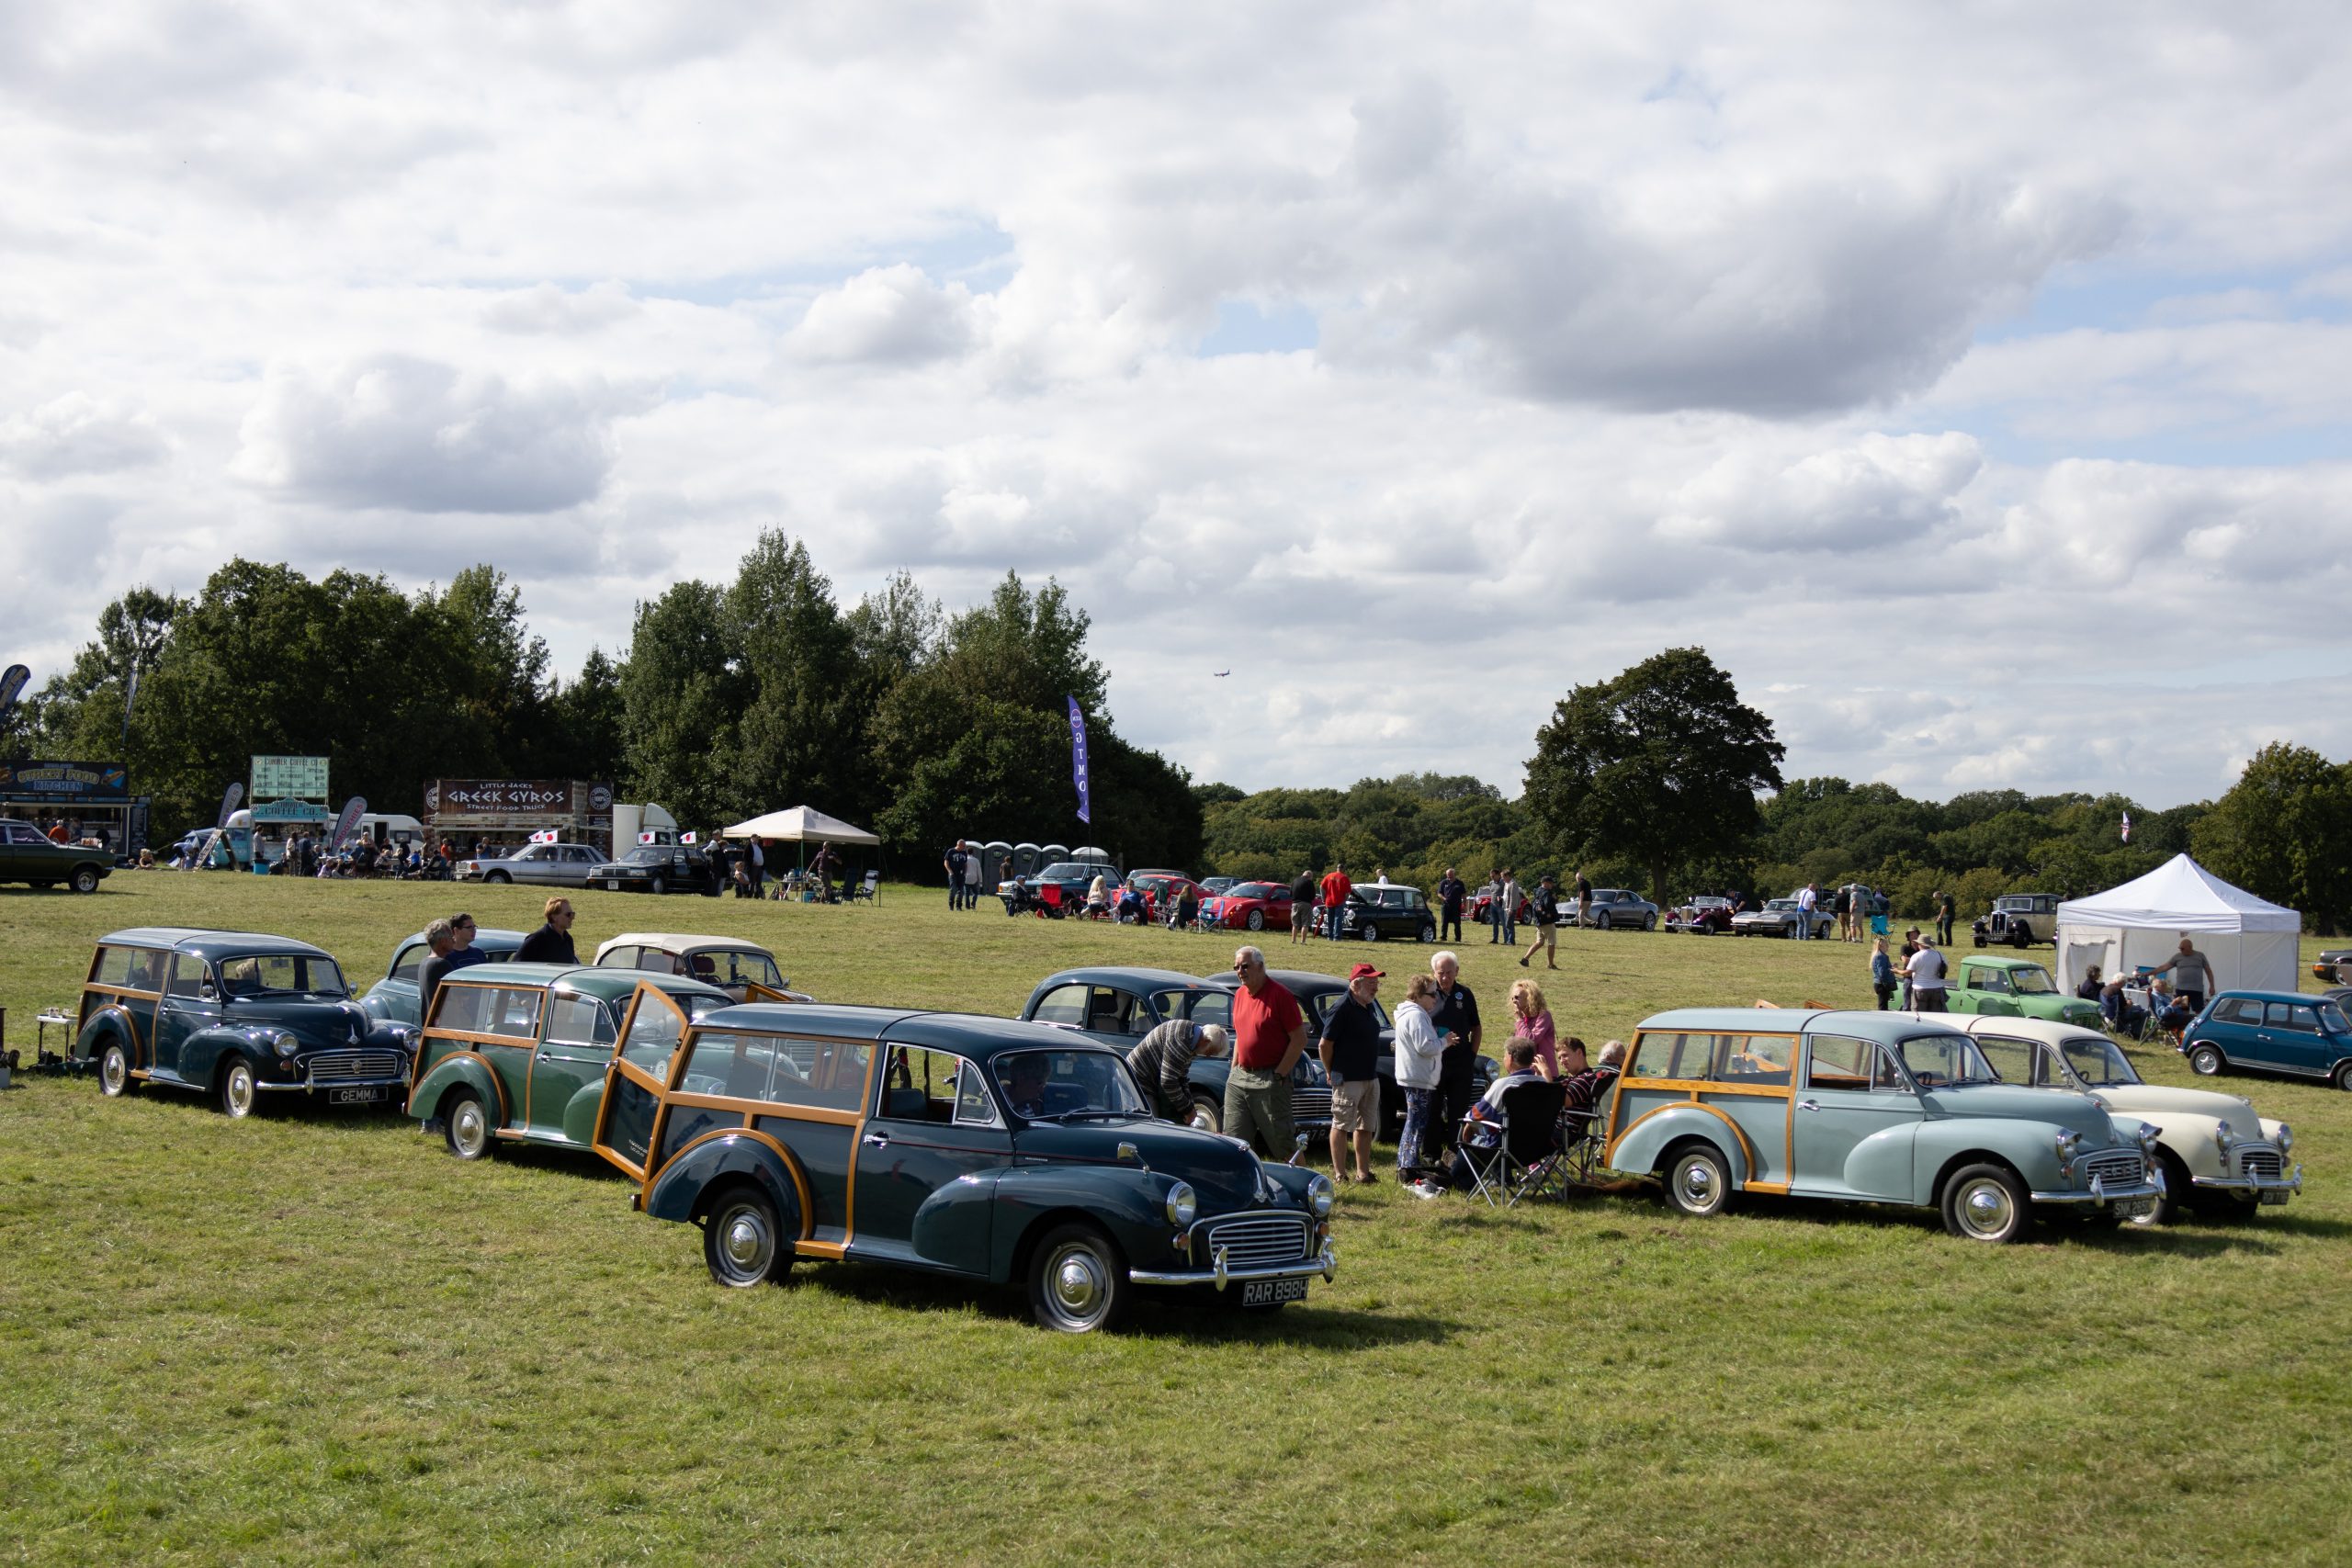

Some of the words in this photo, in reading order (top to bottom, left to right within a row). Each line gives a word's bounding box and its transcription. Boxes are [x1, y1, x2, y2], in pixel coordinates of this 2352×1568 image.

[17, 769, 65, 783] STREET
[66, 769, 99, 784] FOOD
[33, 781, 84, 791] KITCHEN
[447, 790, 503, 803] GREEK
[508, 791, 565, 803] GYROS
[265, 807, 296, 816] COFFEE
[334, 803, 364, 846] SMOOTHIES
[340, 1089, 379, 1101] GEMMA
[1245, 1283, 1273, 1303] RAR
[1274, 1280, 1308, 1300] 898H
